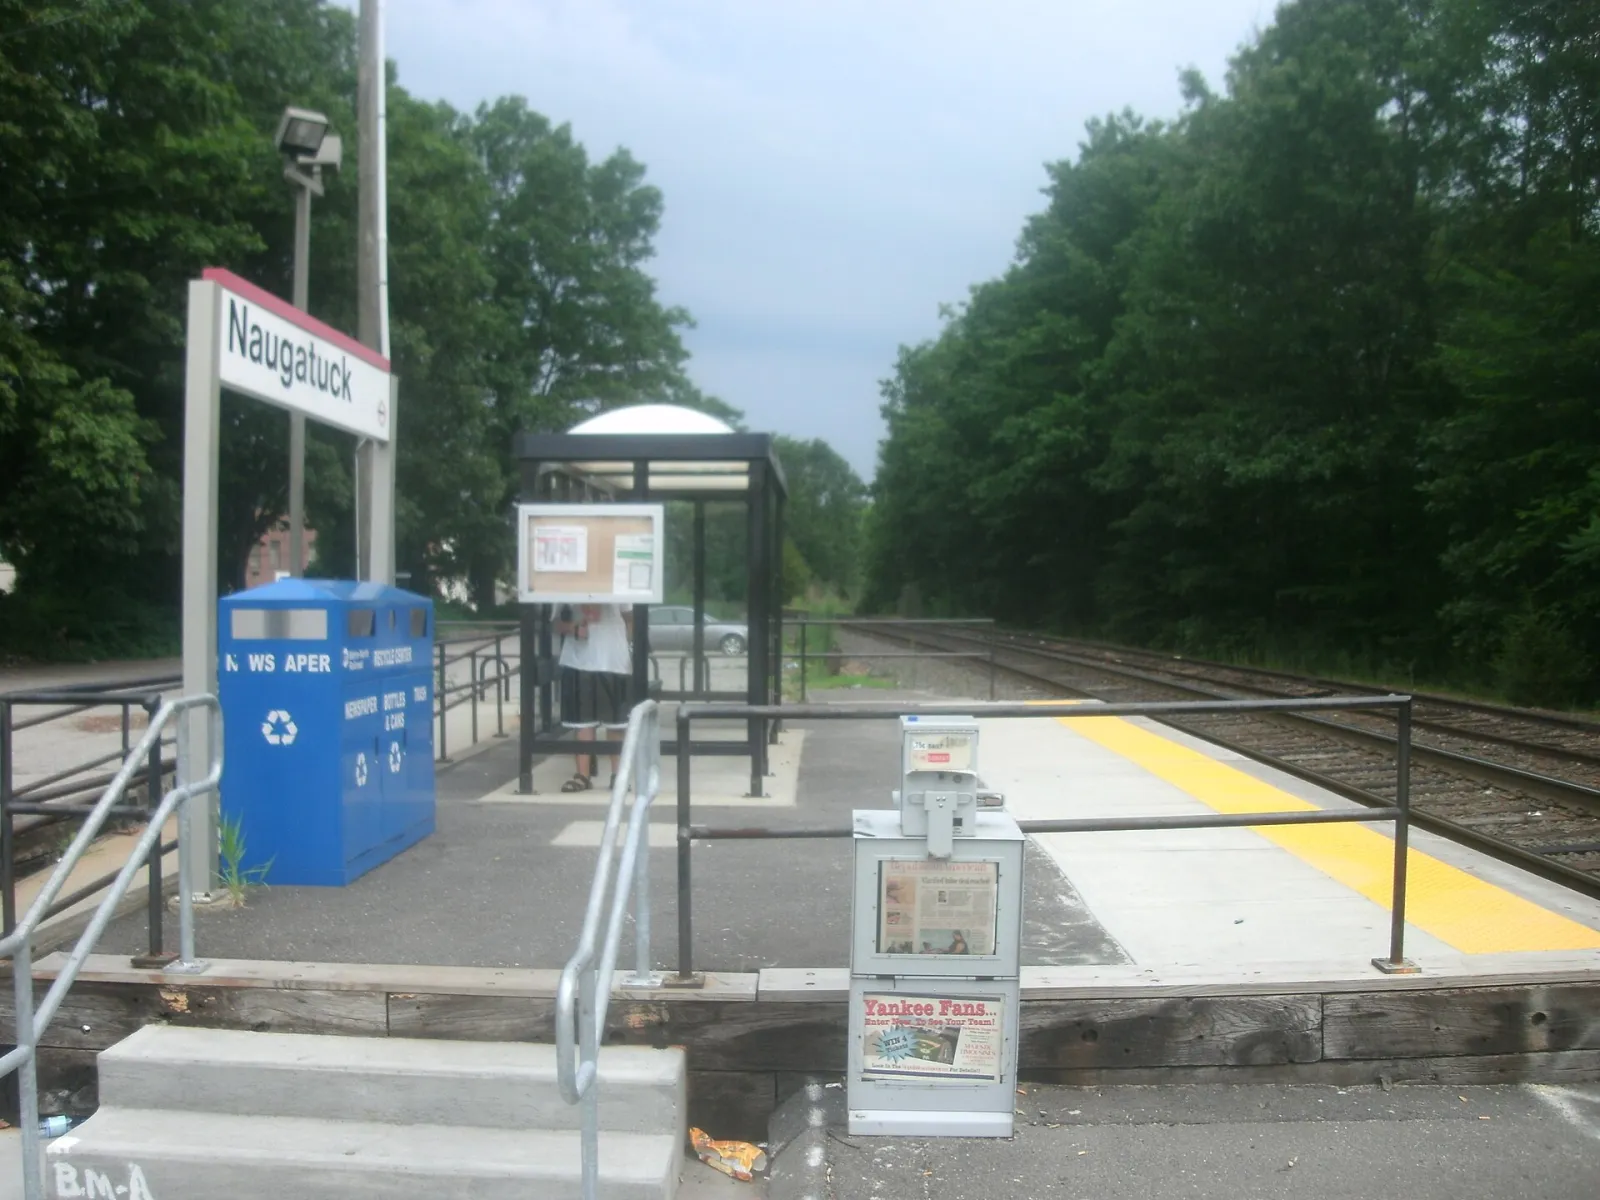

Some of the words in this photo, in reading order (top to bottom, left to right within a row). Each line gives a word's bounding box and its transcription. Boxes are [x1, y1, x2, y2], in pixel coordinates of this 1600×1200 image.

[229, 298, 352, 403] Naugatuck
[863, 1000, 934, 1016] Yankee
[939, 1000, 997, 1017] Fans...
[864, 1018, 889, 1026] Enter
[916, 1018, 927, 1026] To
[928, 1018, 943, 1026] See
[946, 1018, 966, 1026] Your
[967, 1018, 995, 1026] Team!
[883, 1036, 900, 1046] WIN
